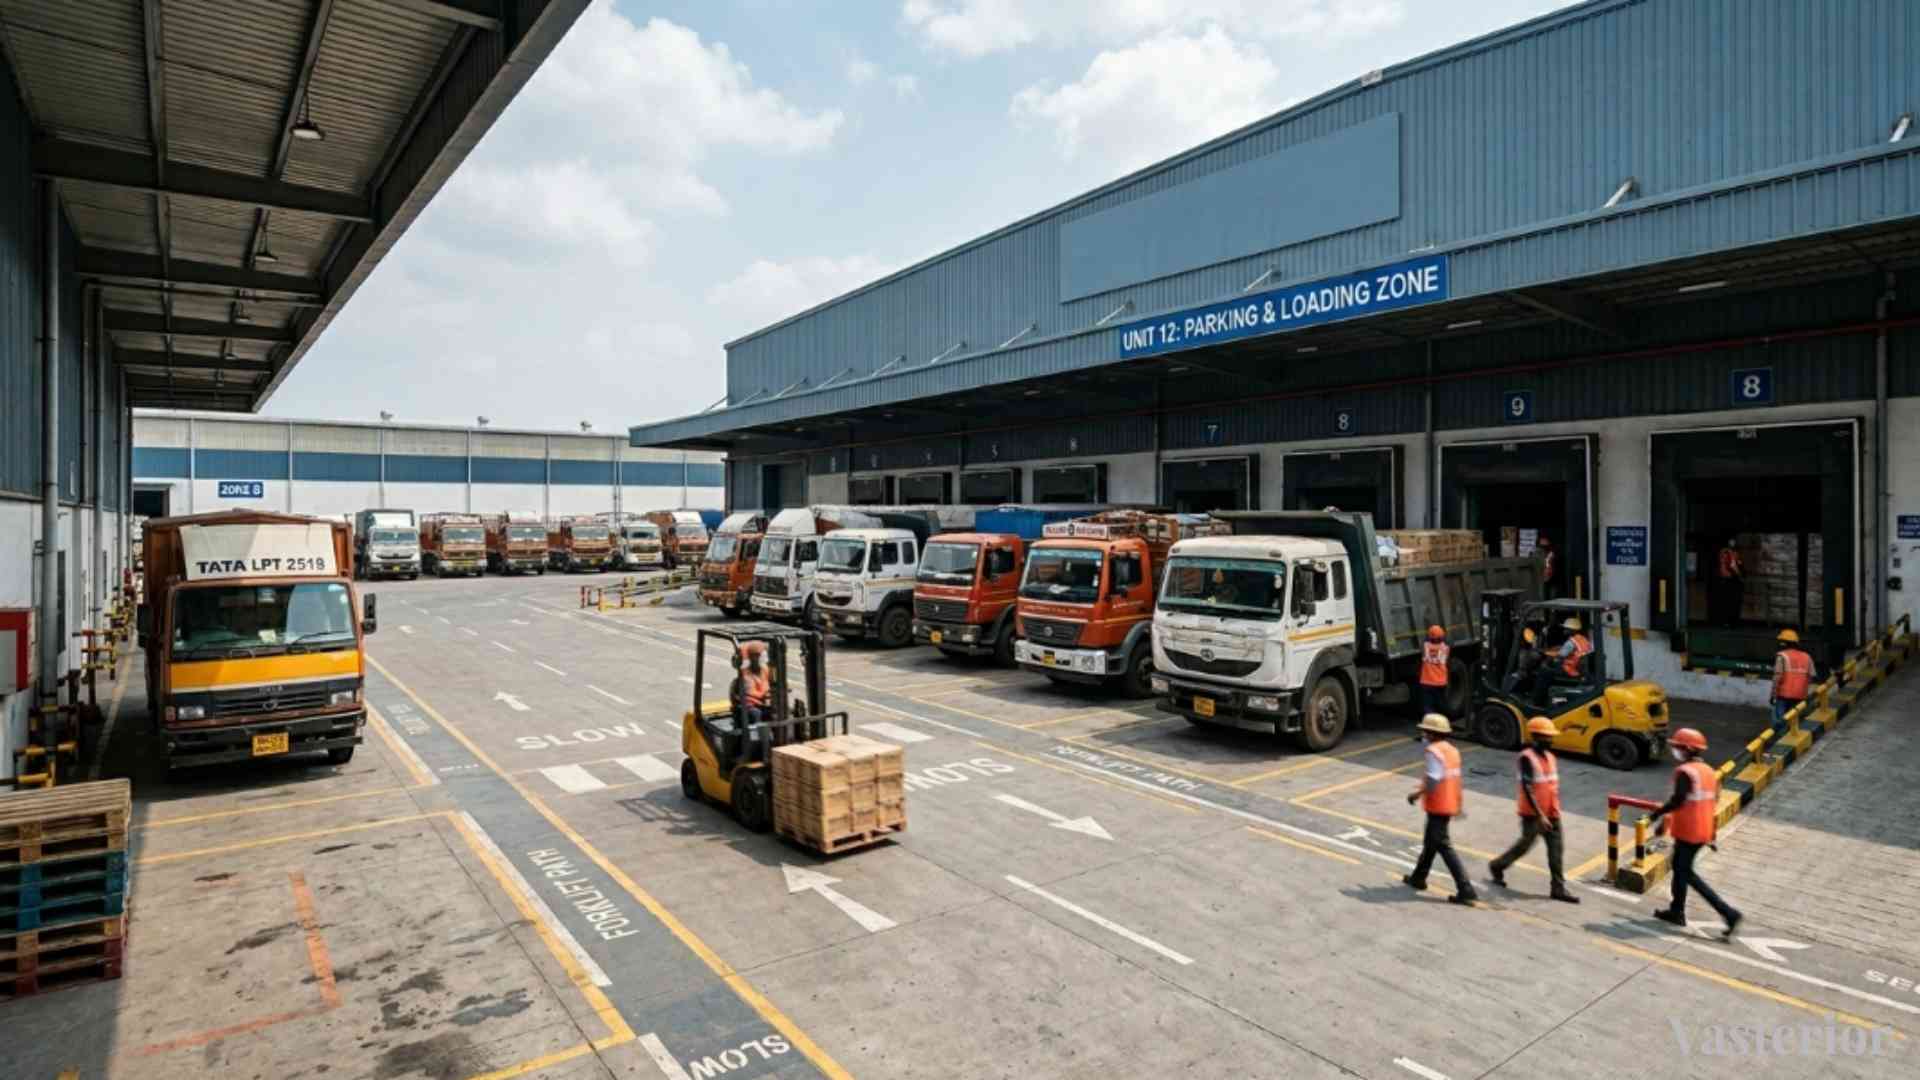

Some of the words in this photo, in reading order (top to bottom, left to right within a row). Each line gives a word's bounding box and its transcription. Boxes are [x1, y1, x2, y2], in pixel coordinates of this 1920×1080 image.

[1123, 326, 1154, 351] UNIT
[1161, 322, 1181, 343] 12:
[1184, 304, 1257, 339] PARKING
[1262, 301, 1276, 324] &
[1281, 284, 1370, 320] LOADING
[1376, 266, 1439, 301] ZONE
[1743, 375, 1760, 398] 8
[1511, 397, 1525, 416] 9
[1207, 424, 1218, 441] 7
[1338, 413, 1349, 430] 8
[196, 559, 246, 574] TATA
[252, 558, 282, 572] LPT
[516, 722, 646, 750] SLOW
[527, 848, 580, 879] PATH
[553, 877, 640, 940] FORKLIFT
